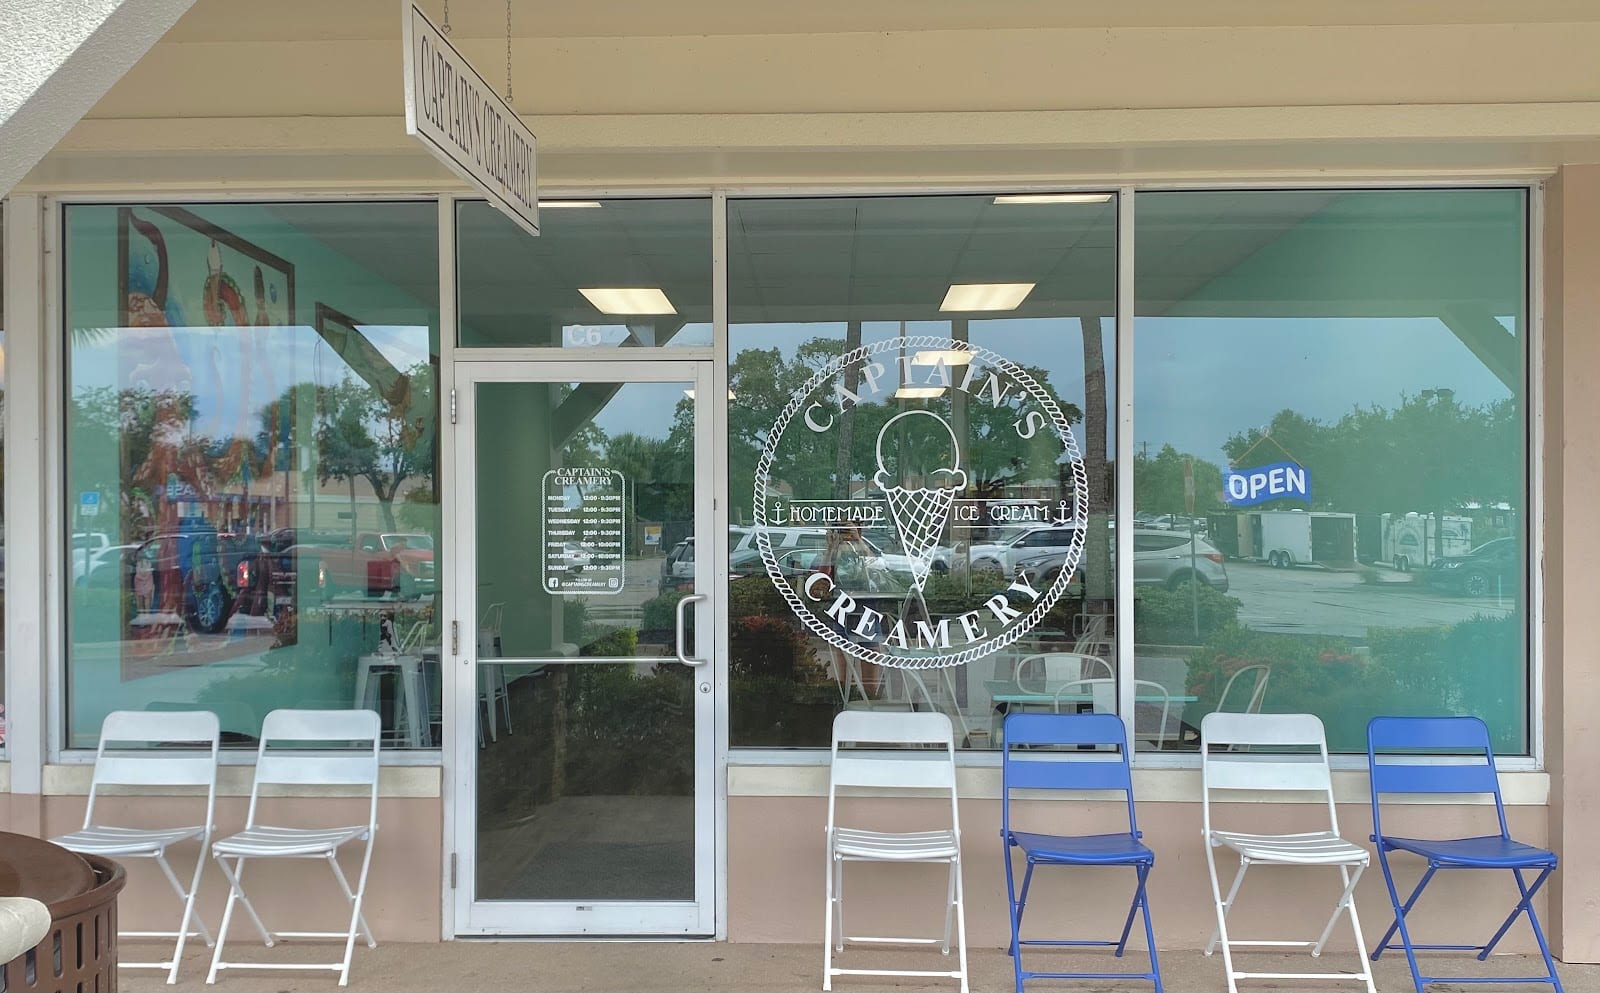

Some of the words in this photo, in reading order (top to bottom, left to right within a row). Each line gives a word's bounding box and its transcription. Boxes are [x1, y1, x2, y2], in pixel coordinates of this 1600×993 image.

[421, 35, 482, 166] CAPTAIN'S
[483, 100, 532, 209] CREAMERY
[570, 324, 602, 346] C6
[804, 355, 1047, 440] CAPTAIN'S
[554, 476, 613, 485] CREAMERY
[557, 468, 611, 476] CAPTAIN'S
[1228, 467, 1306, 500] OPEN
[790, 506, 886, 522] HOMEMADE
[954, 505, 980, 521] ICE
[990, 505, 1049, 521] CREAM
[804, 571, 1042, 650] CREAMERY
